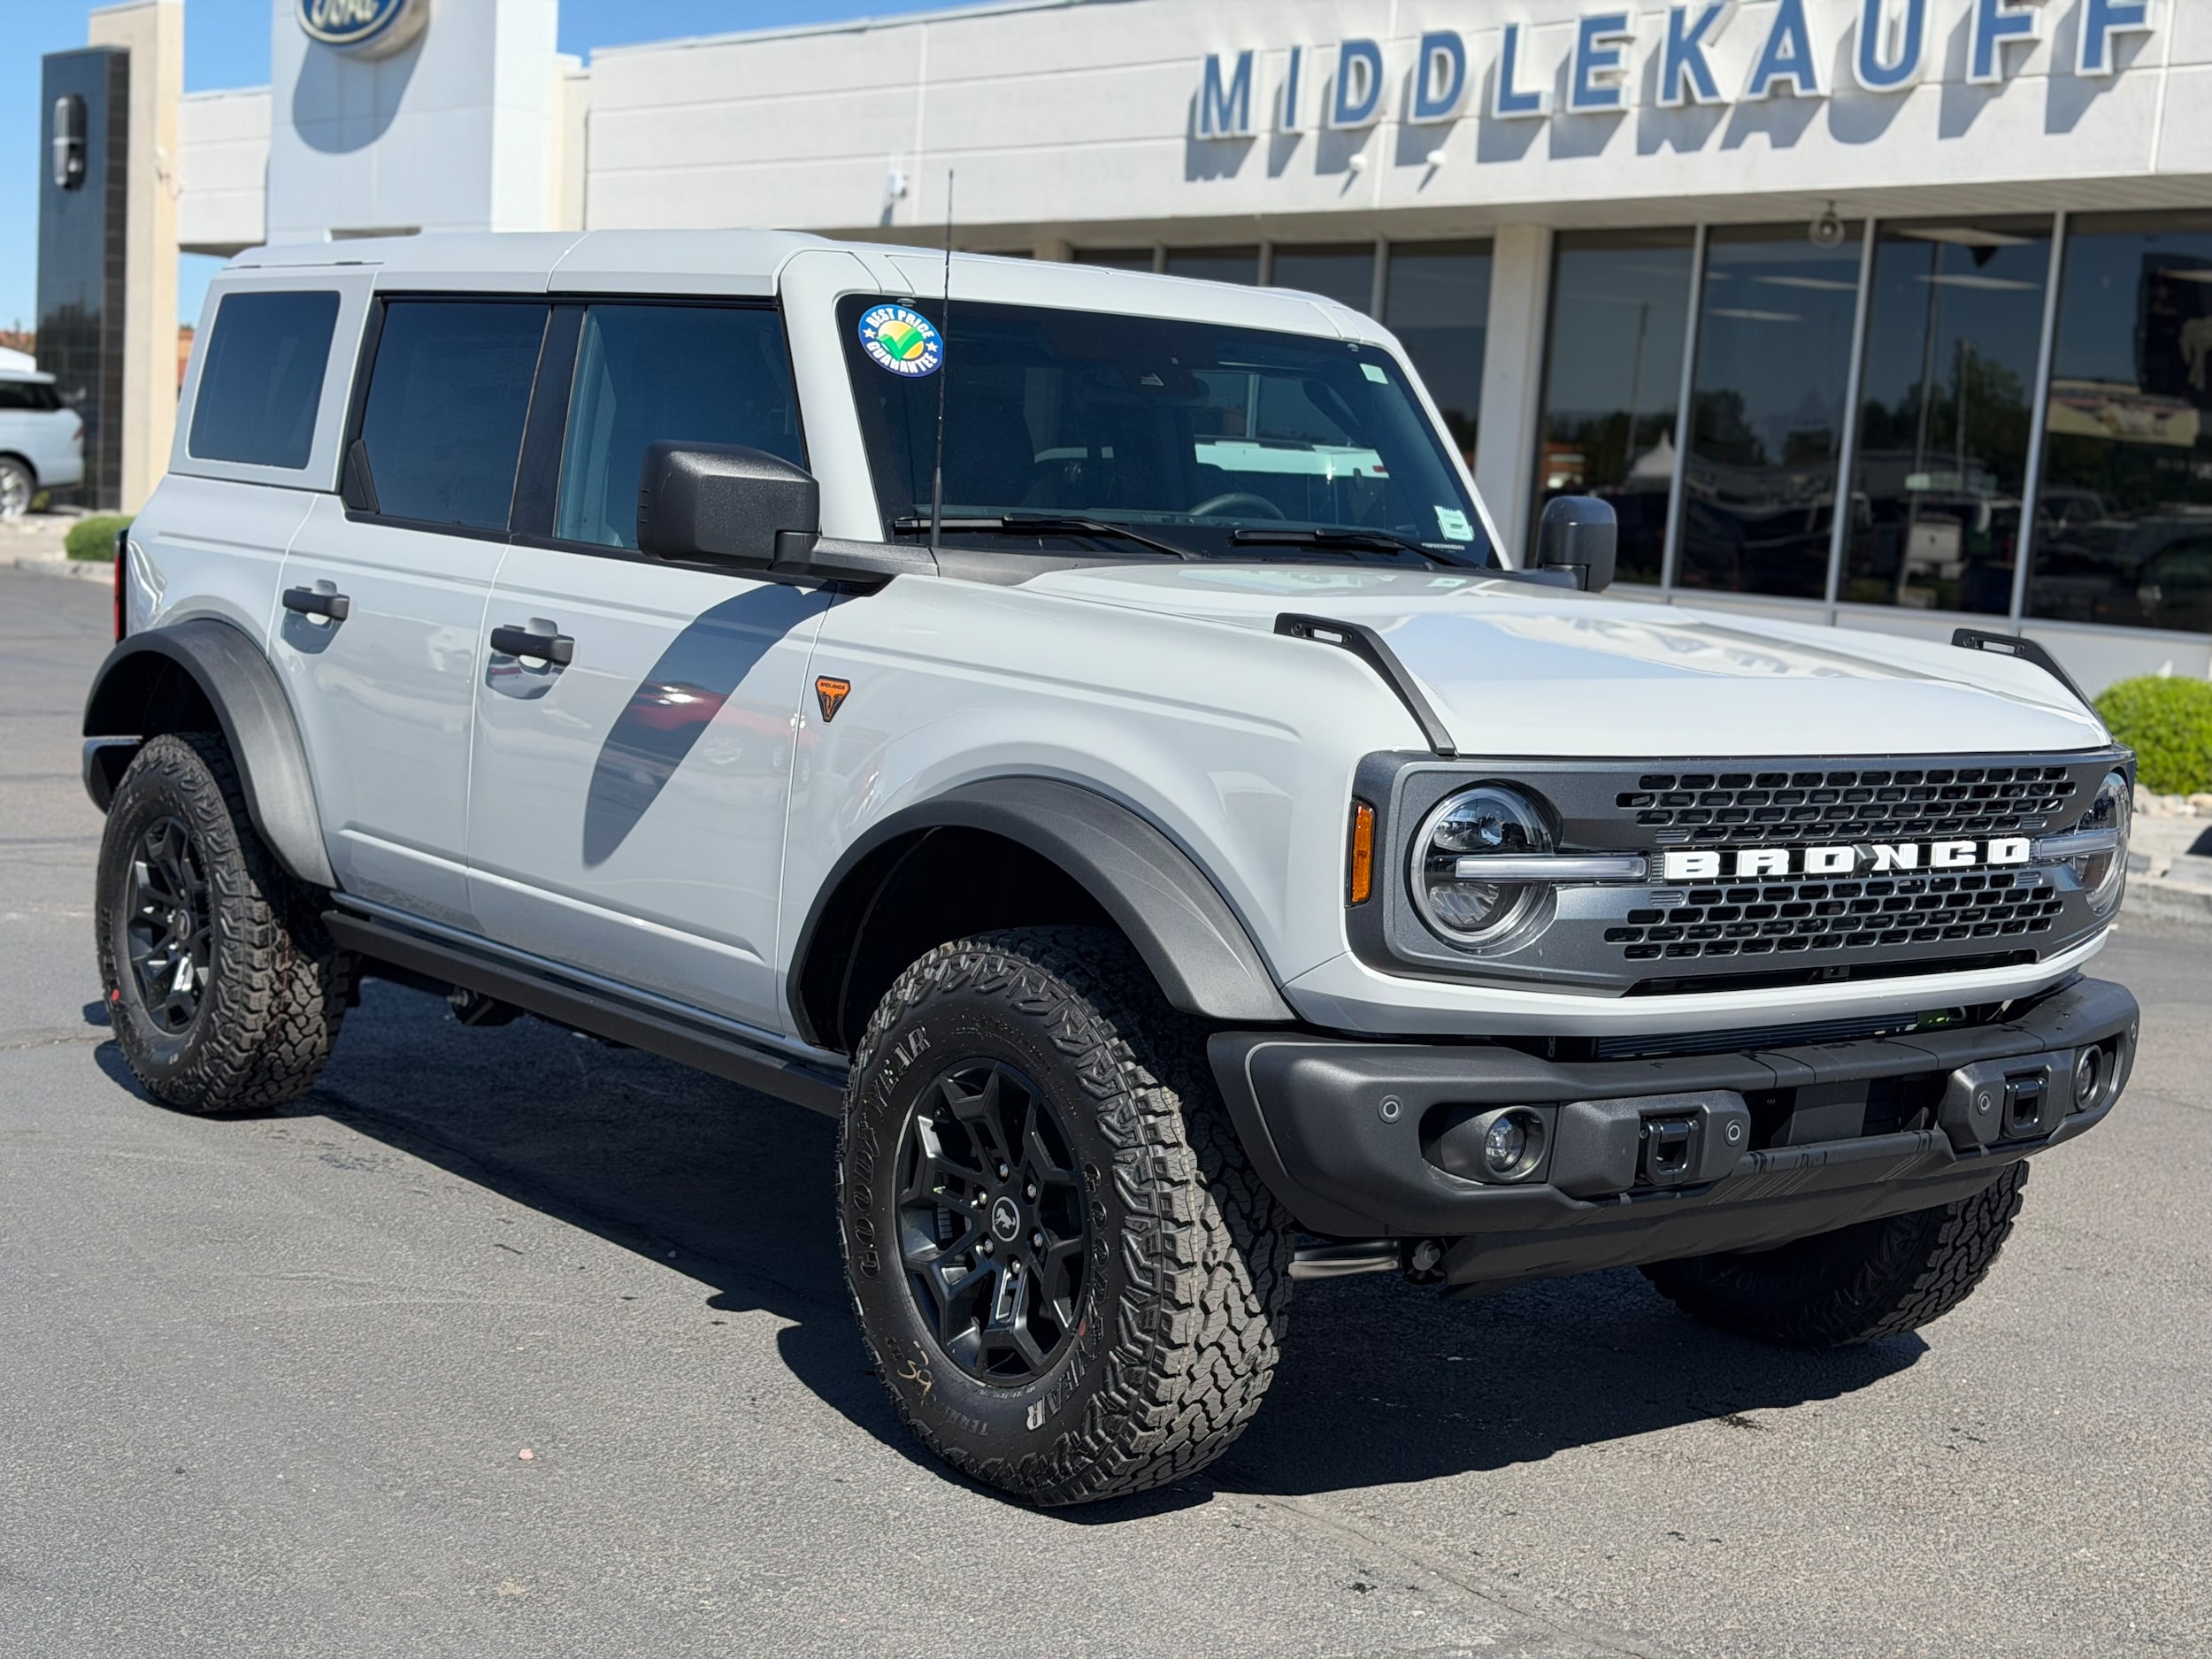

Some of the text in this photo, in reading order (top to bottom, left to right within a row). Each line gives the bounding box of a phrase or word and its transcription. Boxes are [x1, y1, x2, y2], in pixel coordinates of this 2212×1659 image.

[1195, 0, 2154, 139] MIDDLEKAUFF
[865, 307, 935, 339] BEST PRICE
[866, 341, 938, 373] GUARANTEE
[1663, 837, 2032, 880] BRONCO
